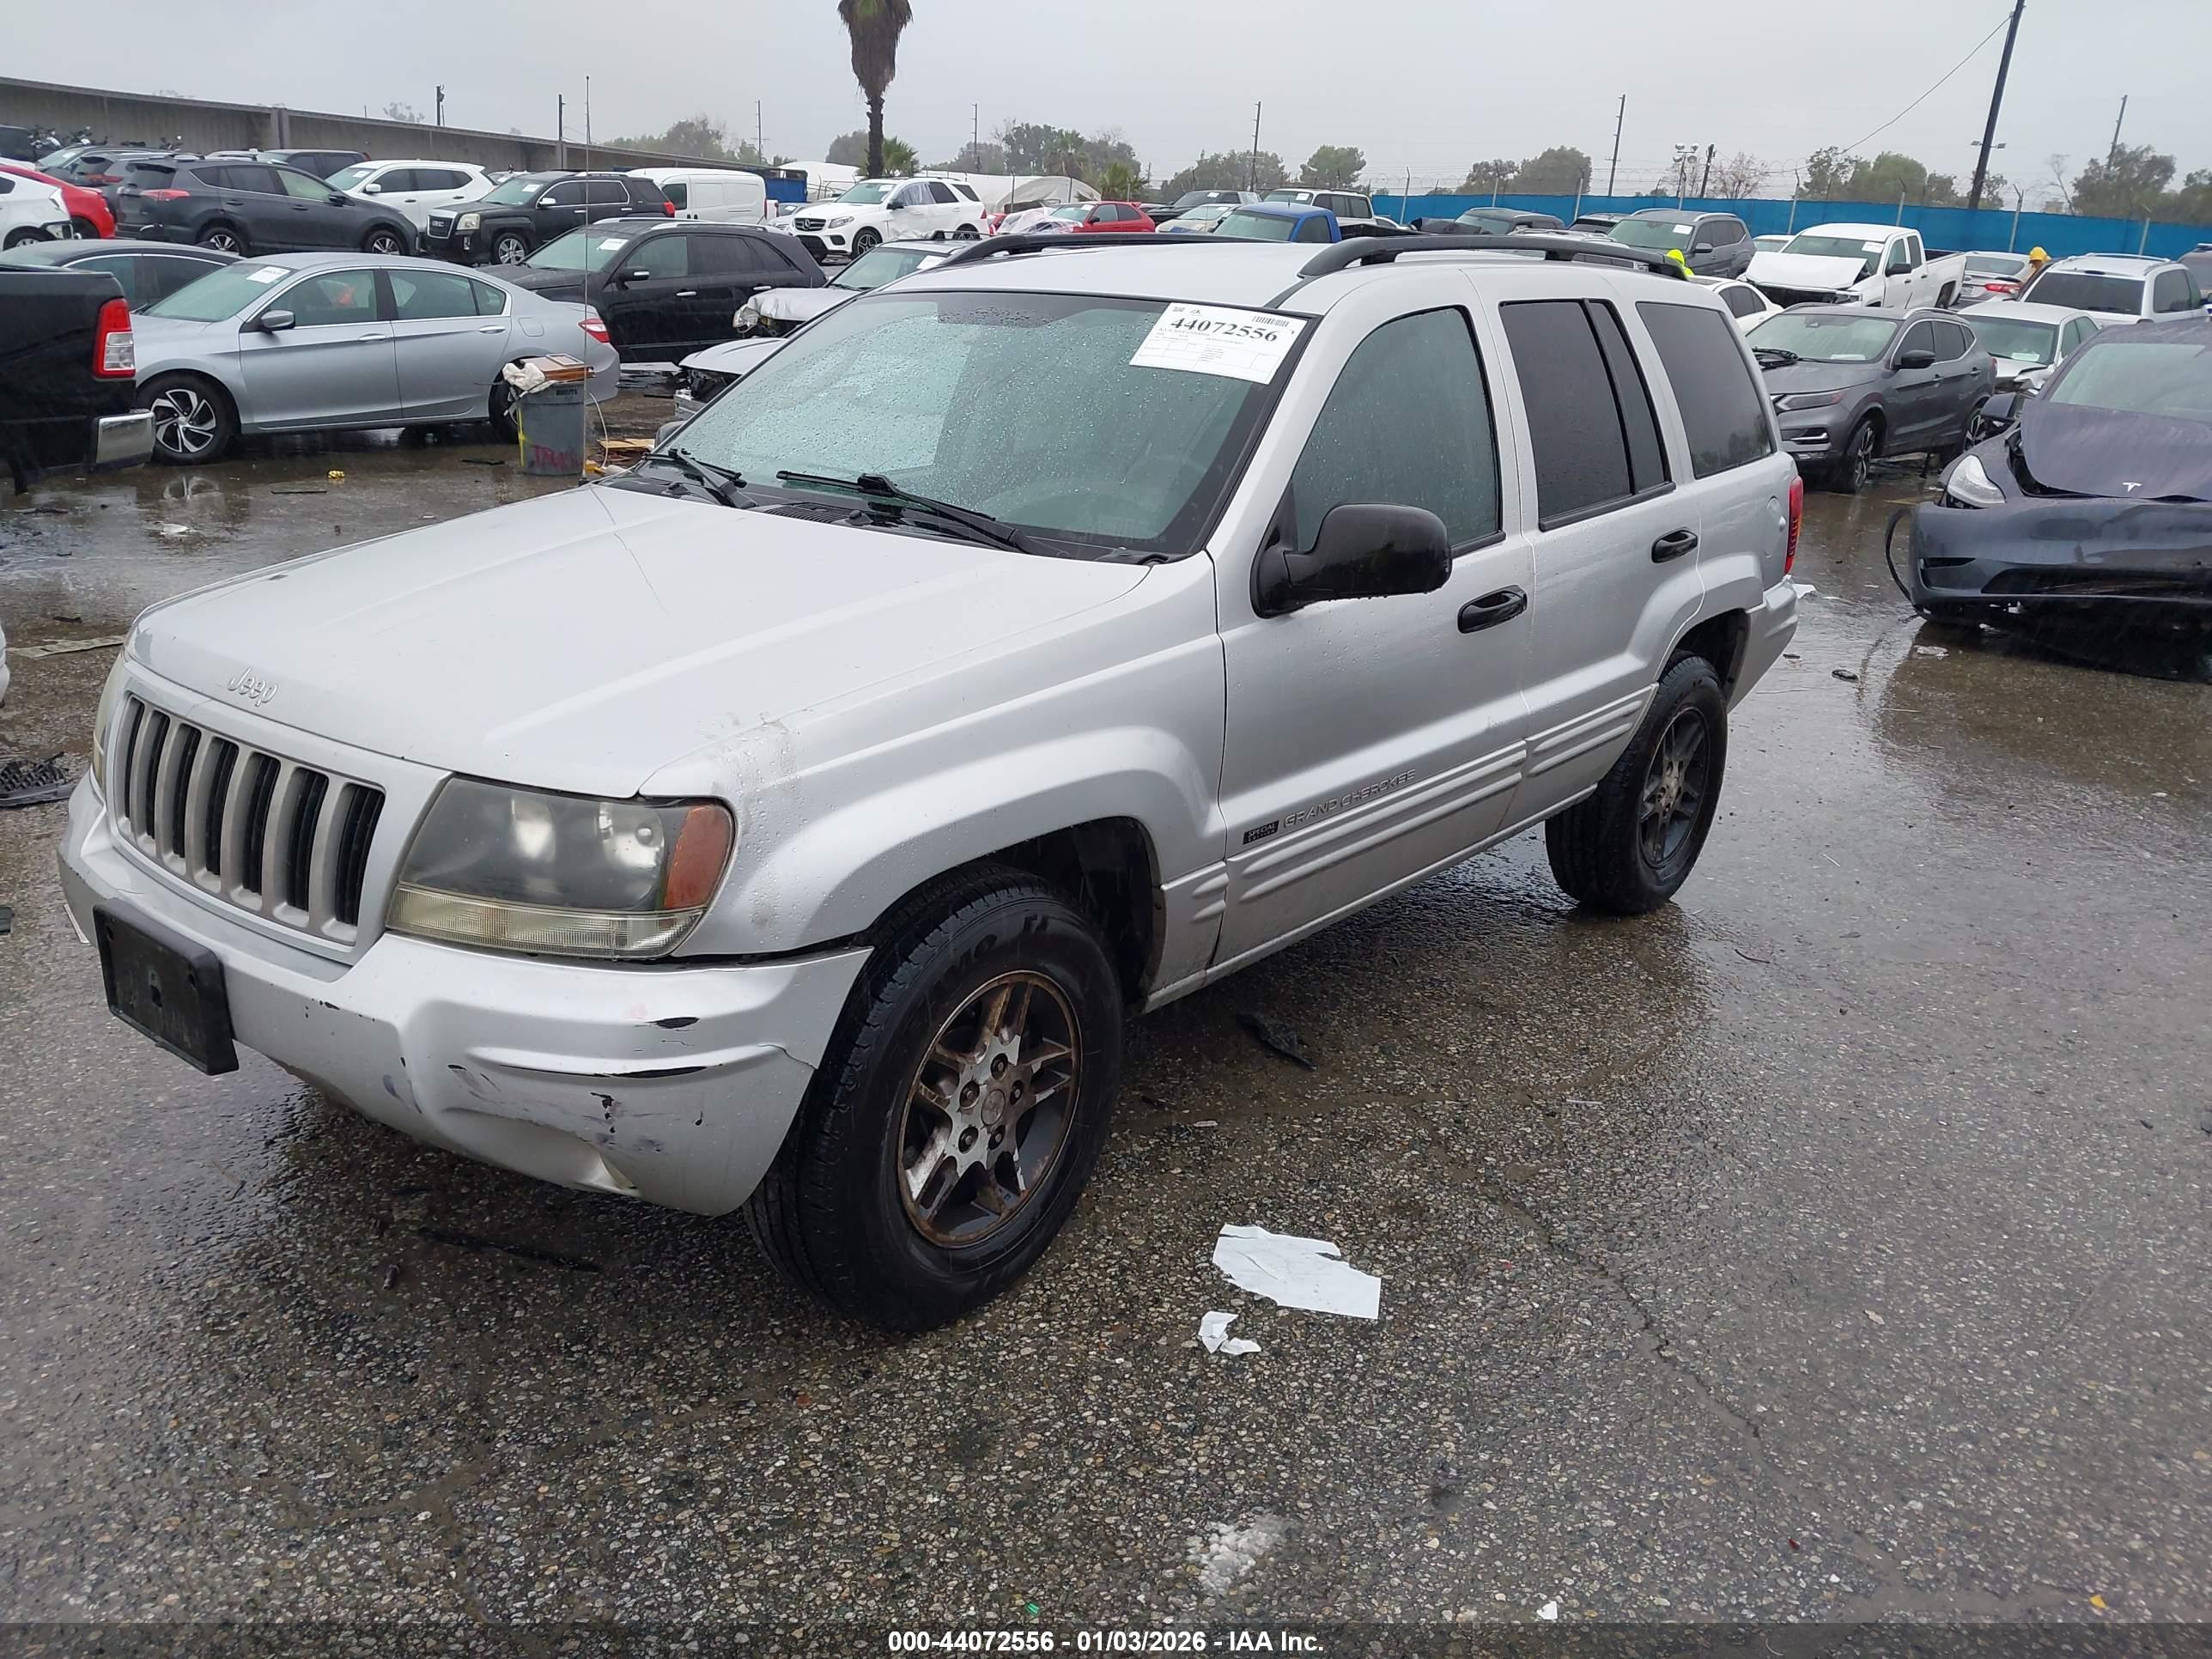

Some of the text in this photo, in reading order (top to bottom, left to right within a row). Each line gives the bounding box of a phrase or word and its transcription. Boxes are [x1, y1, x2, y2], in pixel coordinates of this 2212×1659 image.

[1170, 318, 1279, 342] 44072556
[226, 666, 278, 708] Jeep
[1284, 769, 1415, 829] GRAND CHEROKEE
[1249, 823, 1276, 837] SPECIAL
